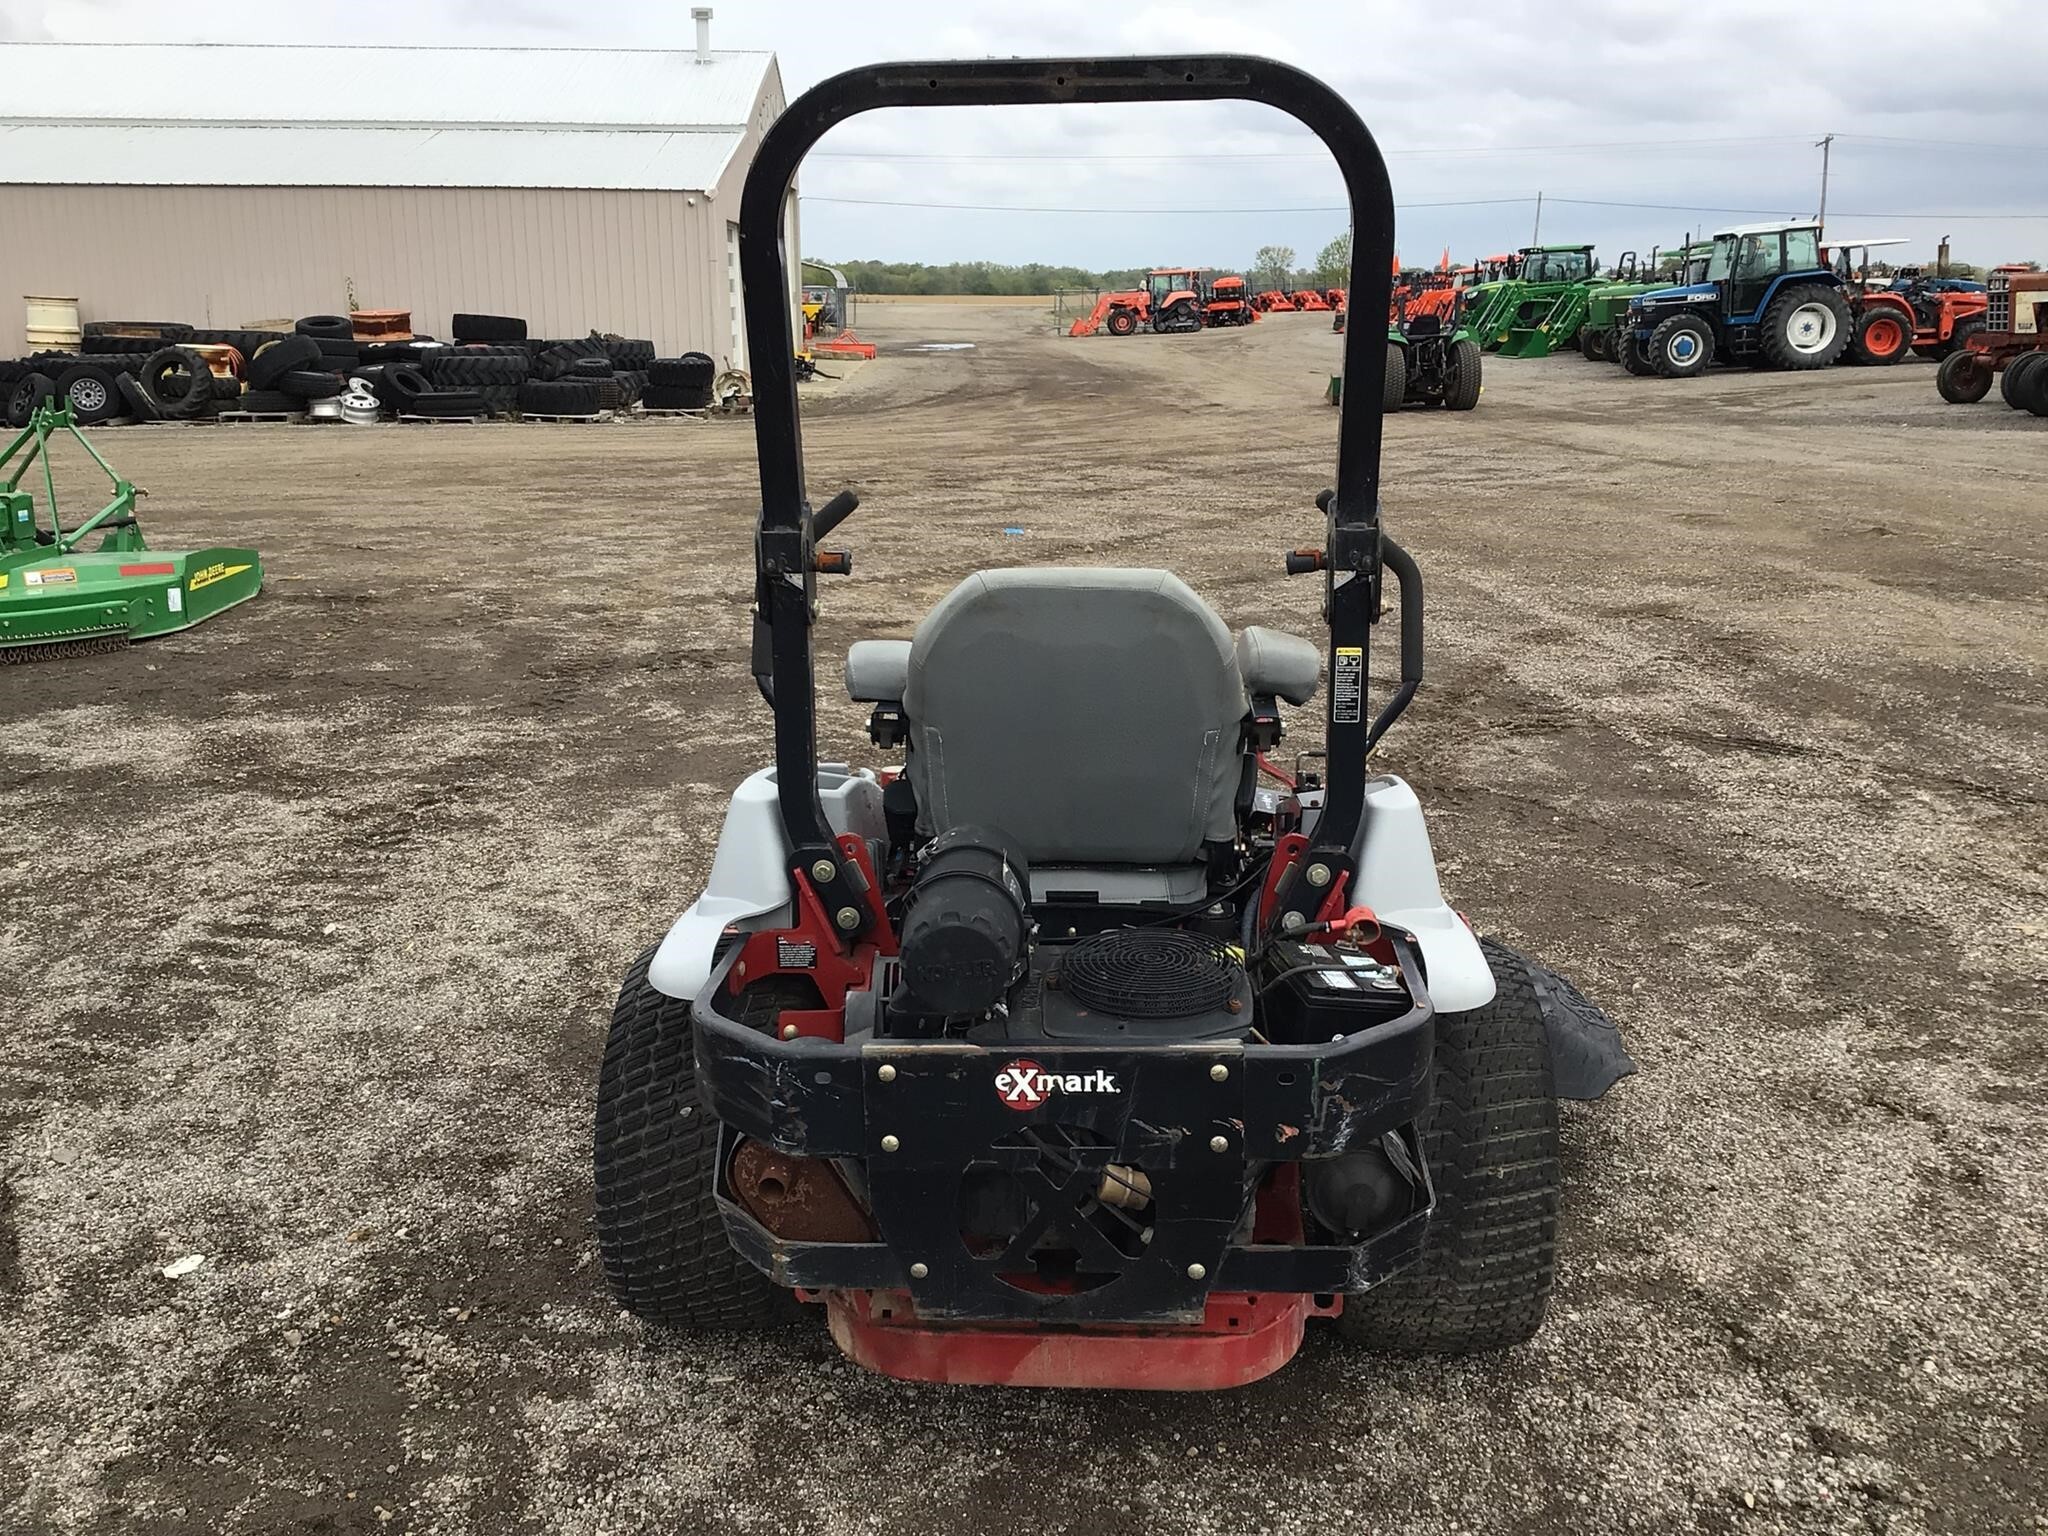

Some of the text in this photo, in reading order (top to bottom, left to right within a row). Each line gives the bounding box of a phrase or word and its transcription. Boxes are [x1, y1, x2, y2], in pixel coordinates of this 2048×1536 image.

[1687, 293, 1717, 303] FORD
[194, 562, 225, 583] JOHN DEERE
